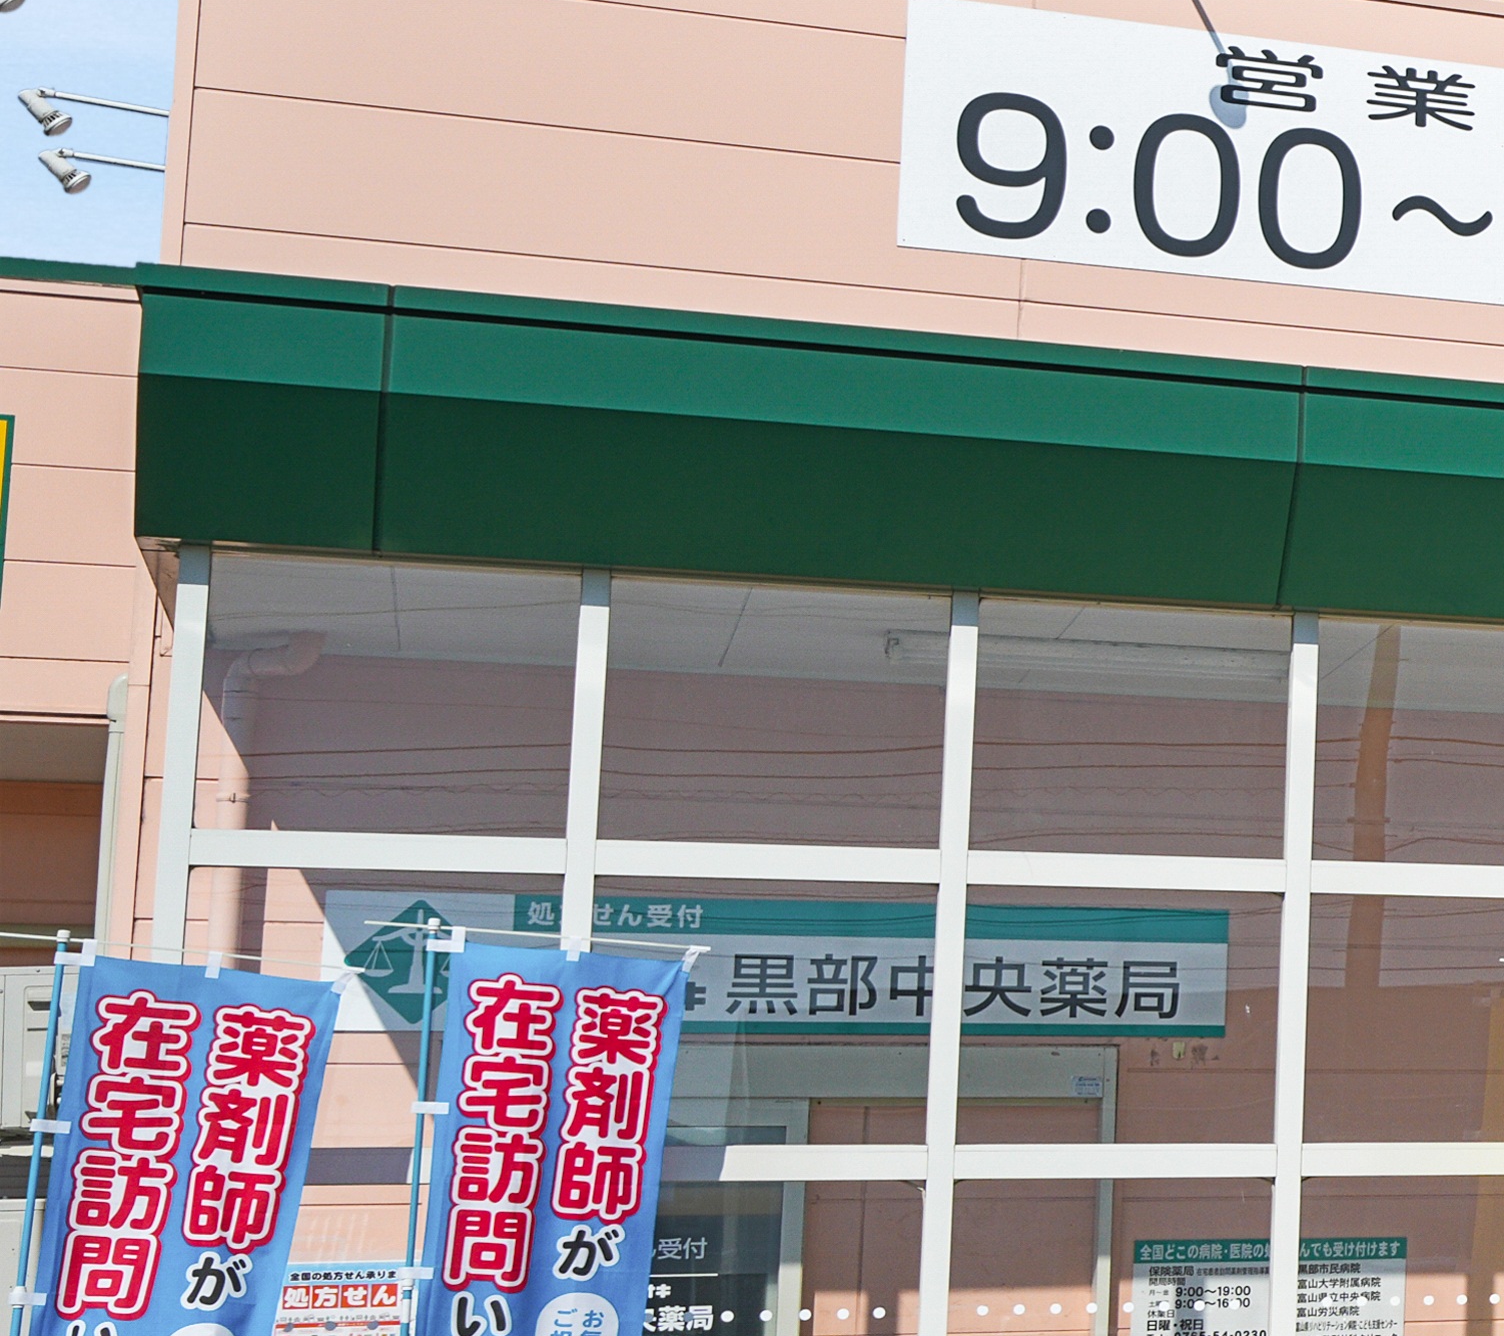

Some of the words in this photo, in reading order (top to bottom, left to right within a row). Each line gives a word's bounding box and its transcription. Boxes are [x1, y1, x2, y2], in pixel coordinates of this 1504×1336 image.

[527, 900, 704, 929] 処せん受付
[551, 986, 668, 1280] 薬剤師が
[183, 1003, 316, 1310] 薬剤師が
[1149, 1266, 1194, 1277] 保険薬局
[284, 1285, 397, 1308] 処方せん
[1147, 1319, 1204, 1331] 日曜・祝日
